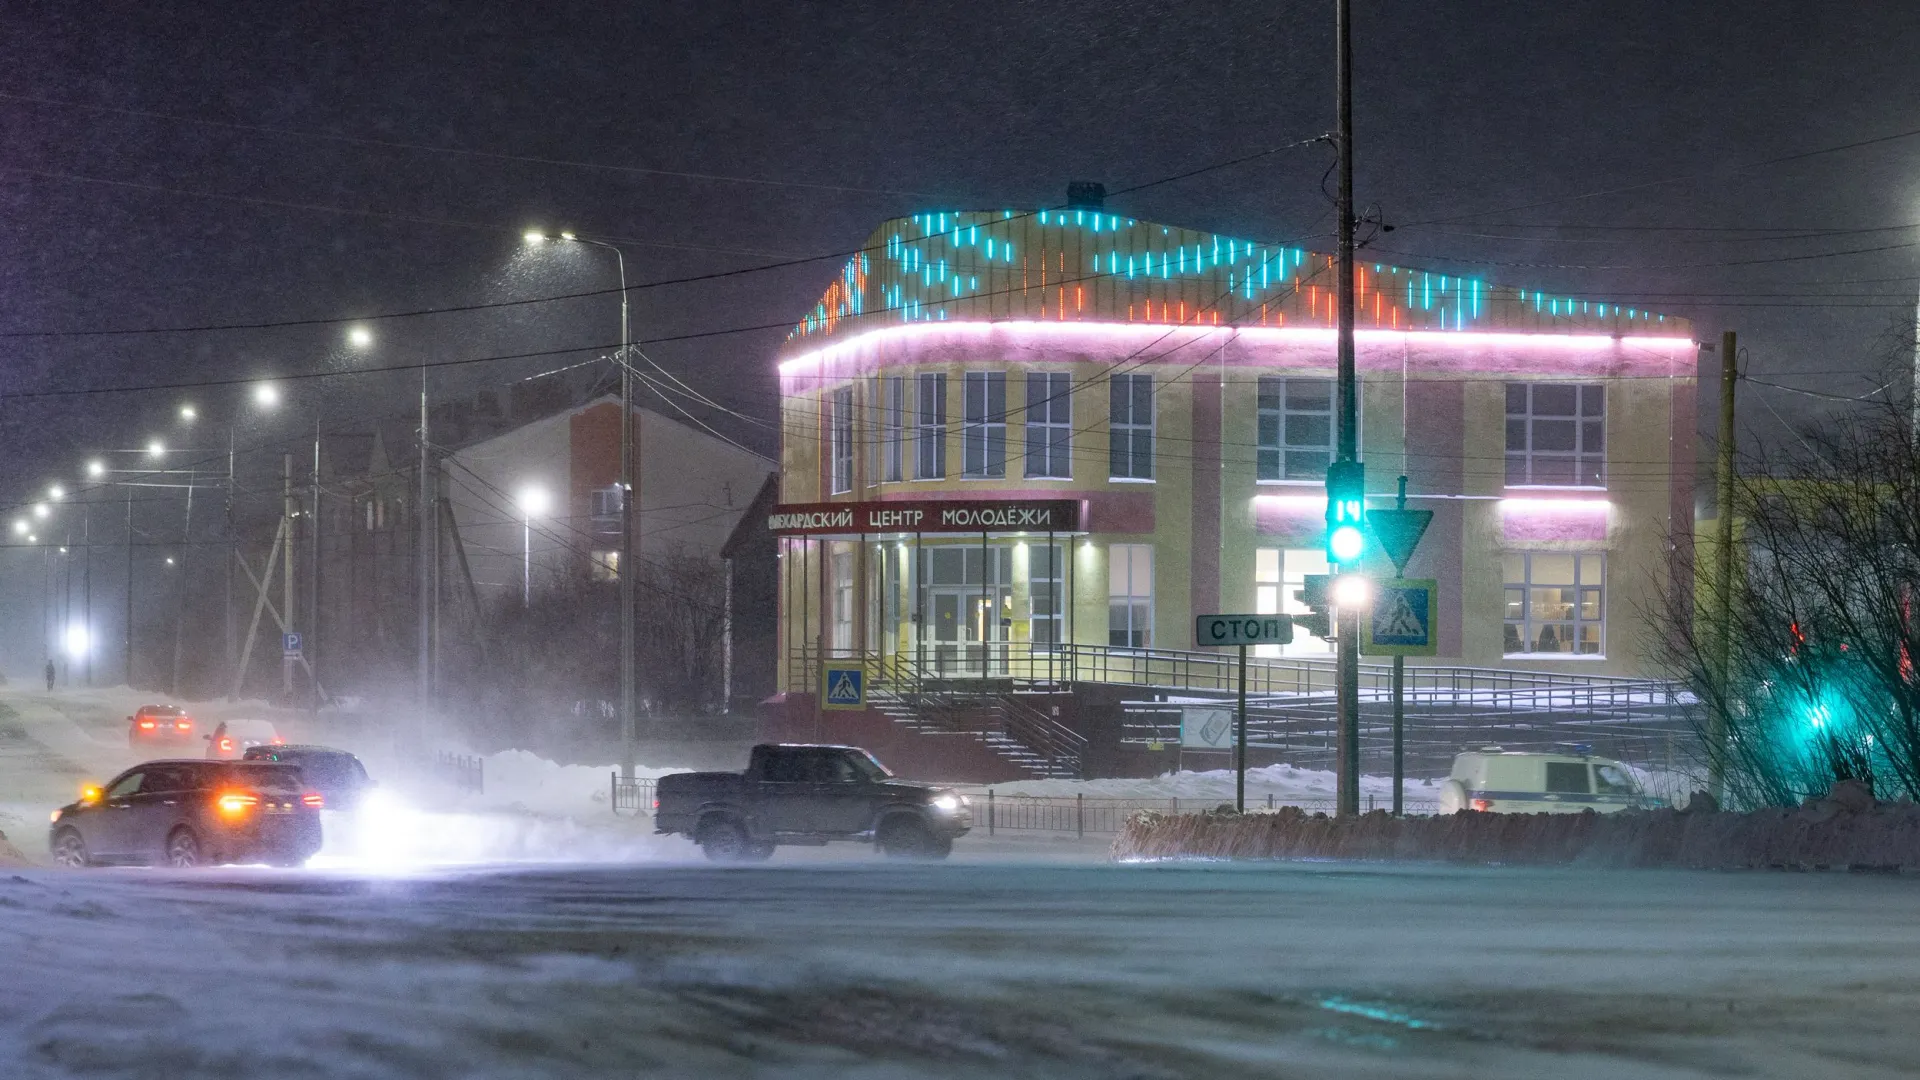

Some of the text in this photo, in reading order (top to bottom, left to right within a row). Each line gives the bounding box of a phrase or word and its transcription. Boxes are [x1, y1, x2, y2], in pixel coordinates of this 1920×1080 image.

[869, 510, 923, 528] ЦЕНТР
[942, 506, 1051, 526] МОЛОДЁЖИ
[1211, 620, 1278, 640] СТОП
